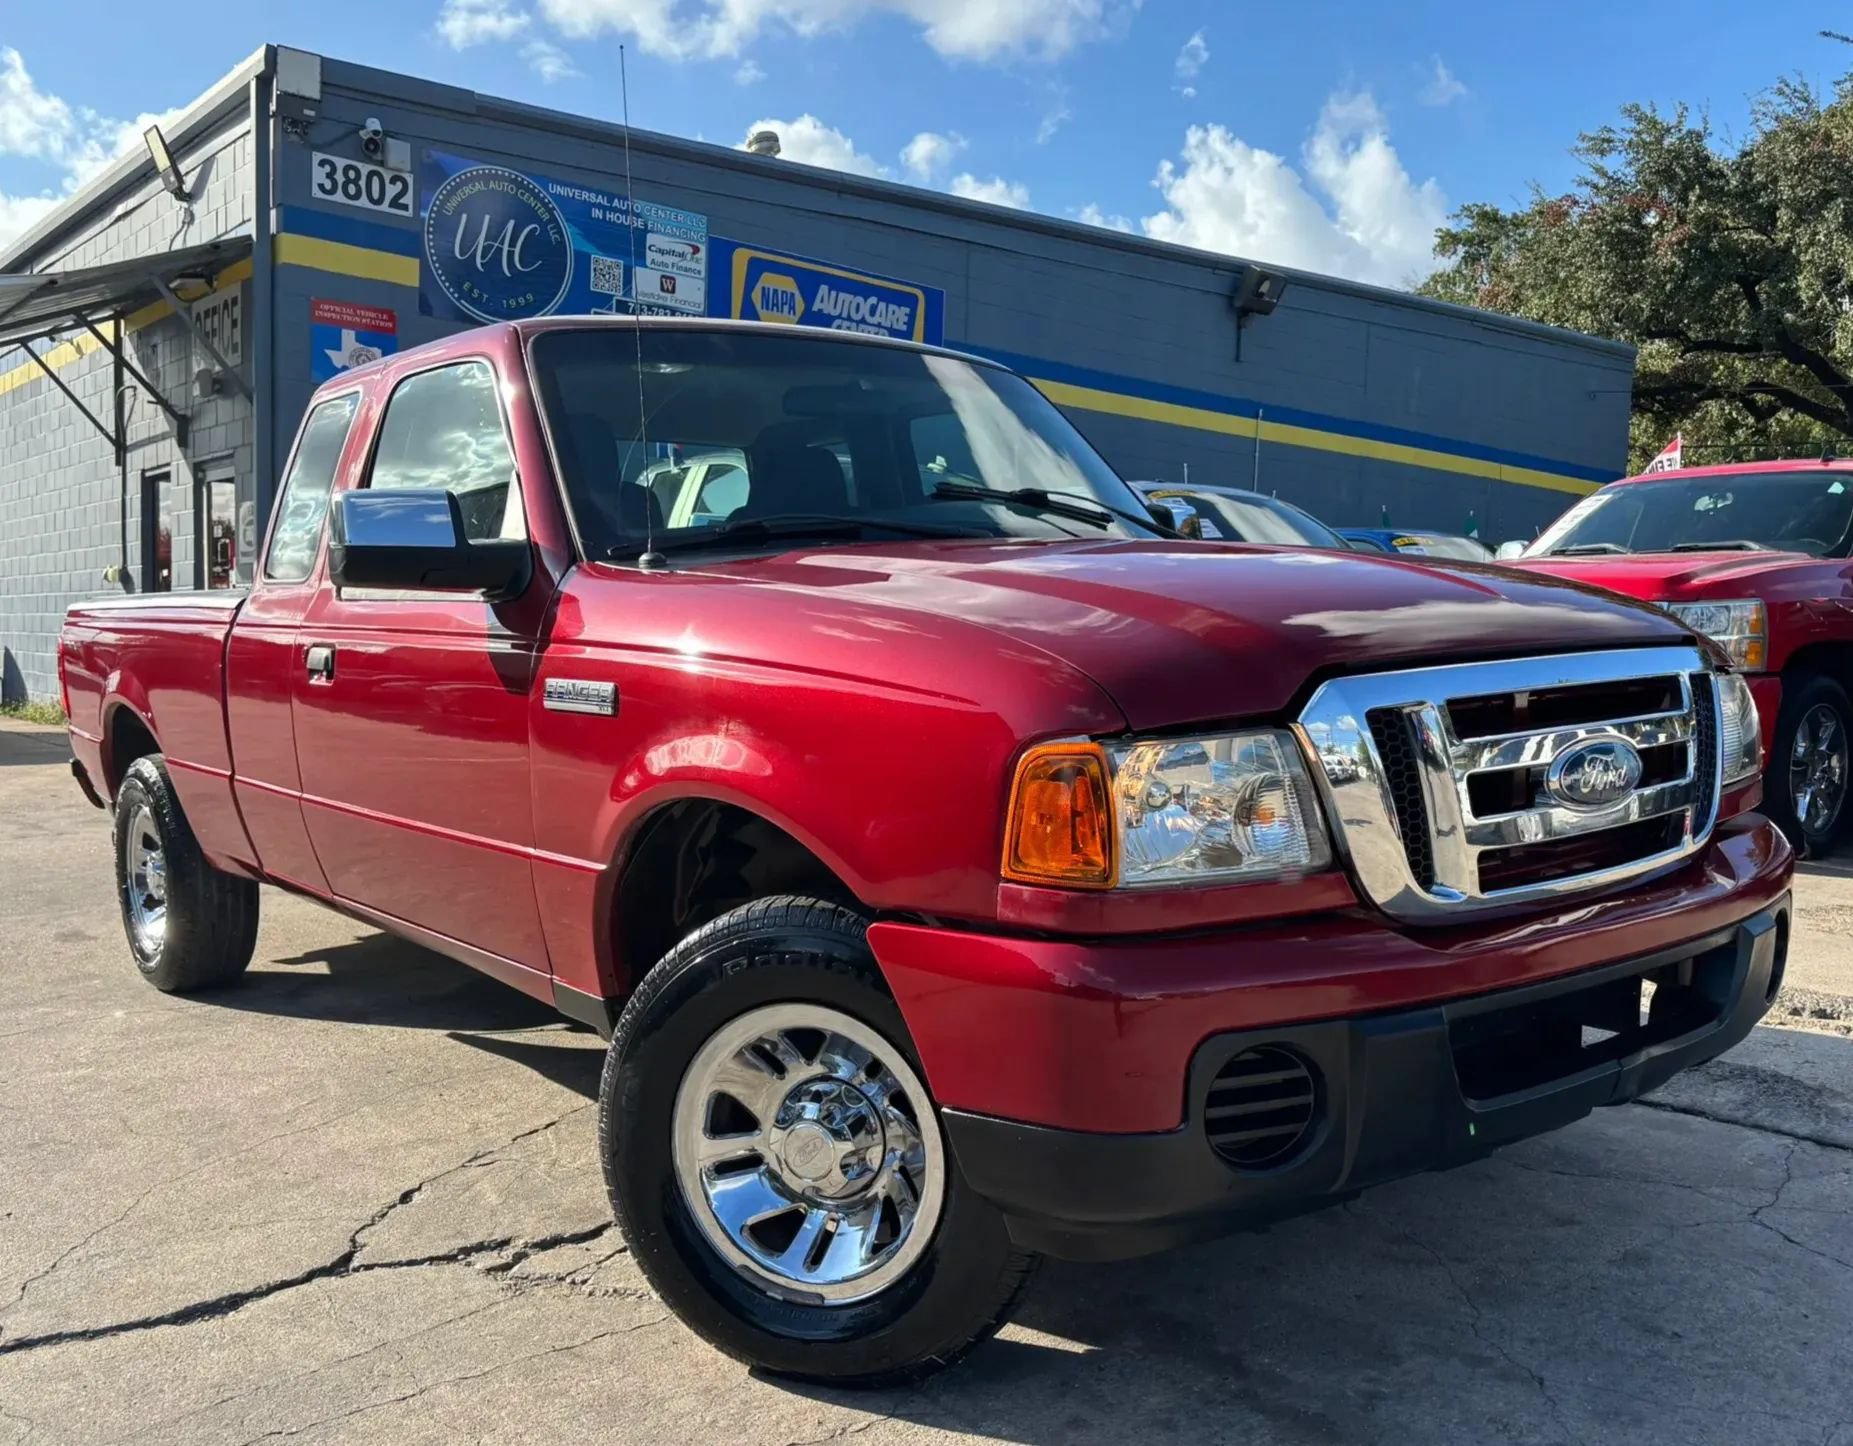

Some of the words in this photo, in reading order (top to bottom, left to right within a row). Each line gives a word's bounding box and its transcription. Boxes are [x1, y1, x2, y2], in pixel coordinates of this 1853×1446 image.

[317, 158, 409, 212] 3802
[443, 180, 486, 216] UNIVERSAL
[489, 181, 516, 195] AUTO
[517, 188, 550, 222] CENTER
[549, 182, 611, 207] UNIVERSAL
[612, 198, 641, 213] AUTO
[643, 205, 684, 224] CENTER
[686, 216, 707, 228] LLC
[591, 207, 603, 220] IN
[605, 209, 645, 229] HOUSE
[647, 221, 706, 242] FINANCING
[454, 212, 543, 277] UAC
[650, 258, 669, 269] Auto
[671, 262, 702, 276] Finance
[502, 292, 534, 309] 1999
[661, 278, 674, 292] W
[760, 285, 796, 317] NAPA
[195, 296, 239, 360] OFFICE
[314, 310, 361, 323] INSPECTION
[362, 317, 393, 328] STATION
[320, 303, 354, 315] OFFICIAL
[356, 309, 388, 320] VEHICLE
[545, 680, 614, 703] RANGER
[1580, 753, 1628, 793] Ford
